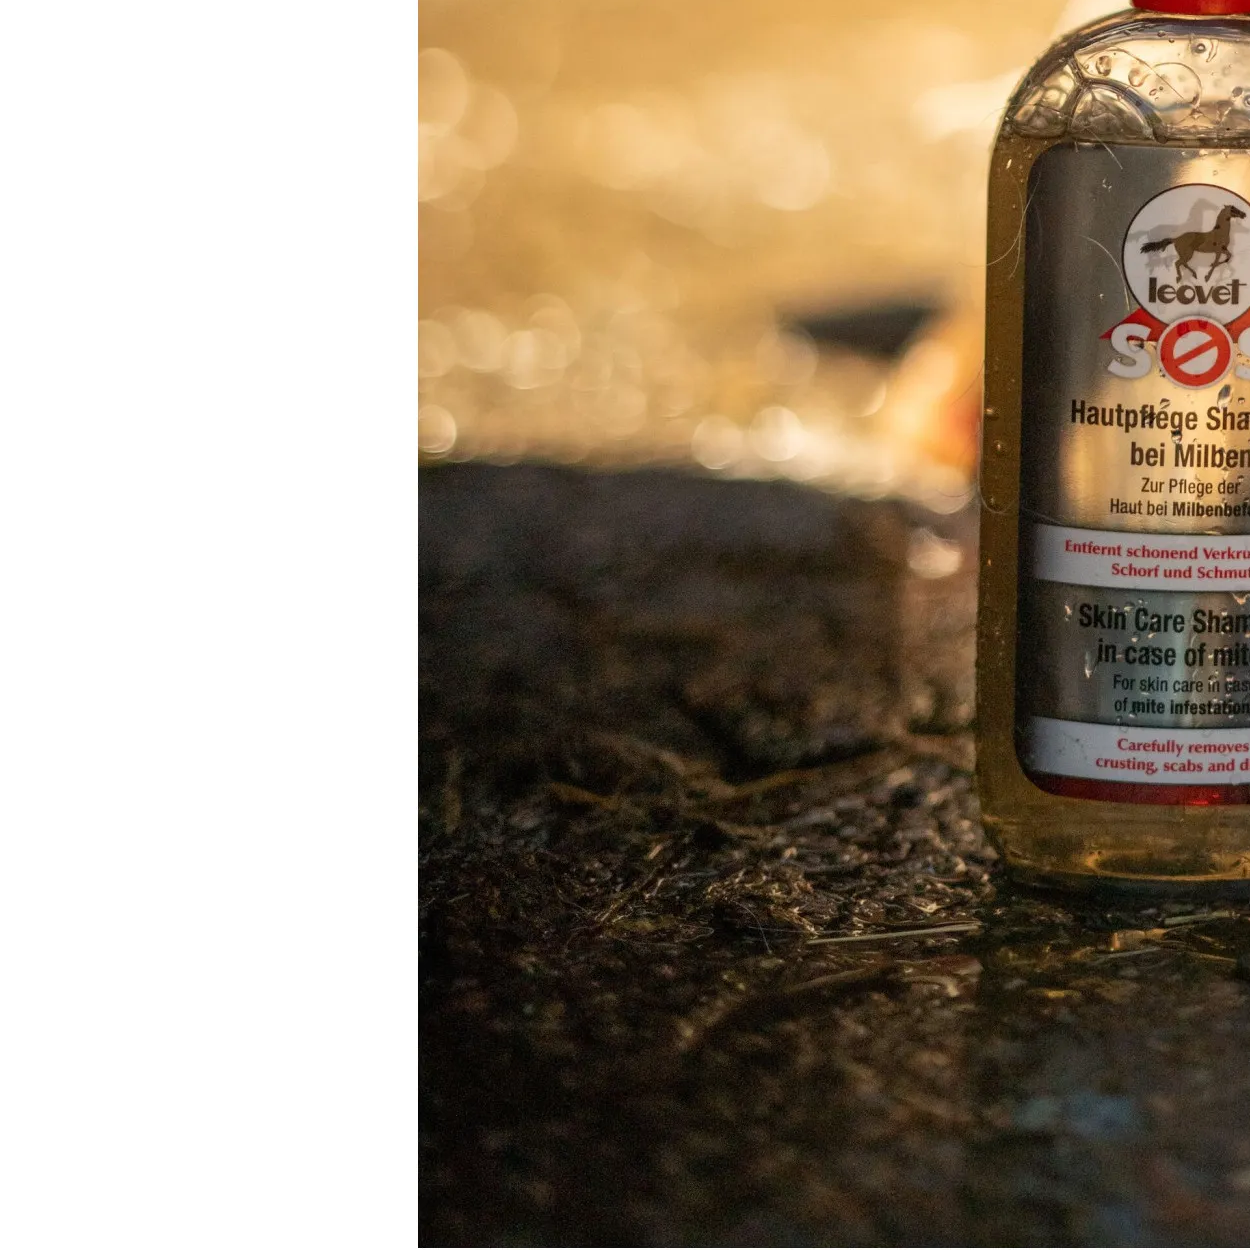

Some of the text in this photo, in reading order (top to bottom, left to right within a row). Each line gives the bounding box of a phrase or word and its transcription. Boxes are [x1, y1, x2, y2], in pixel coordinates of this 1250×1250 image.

[1148, 277, 1247, 305] leovet
[1071, 399, 1198, 433] Hautpflege
[1131, 442, 1165, 467] bei
[1141, 477, 1241, 497] Zur Pflege der
[1110, 498, 1143, 515] Haut
[1147, 500, 1168, 516] bei
[1064, 539, 1122, 557] Entfernt
[1127, 544, 1198, 560] schonend
[1111, 562, 1160, 578] Schorf
[1163, 565, 1192, 579] und
[1079, 603, 1127, 630] Skin
[1135, 607, 1185, 633] Care
[1098, 638, 1117, 663] in
[1124, 645, 1177, 667] case
[1184, 642, 1206, 667] of
[1113, 674, 1136, 691] For
[1139, 676, 1168, 692] skin
[1173, 679, 1203, 693] care
[1208, 677, 1220, 692] in
[1114, 698, 1127, 712] of
[1132, 698, 1165, 714] mite
[1117, 738, 1249, 757] Carefully removes
[1096, 757, 1158, 775] crusting,
[1163, 759, 1203, 772] scabs
[1208, 759, 1236, 772] and
